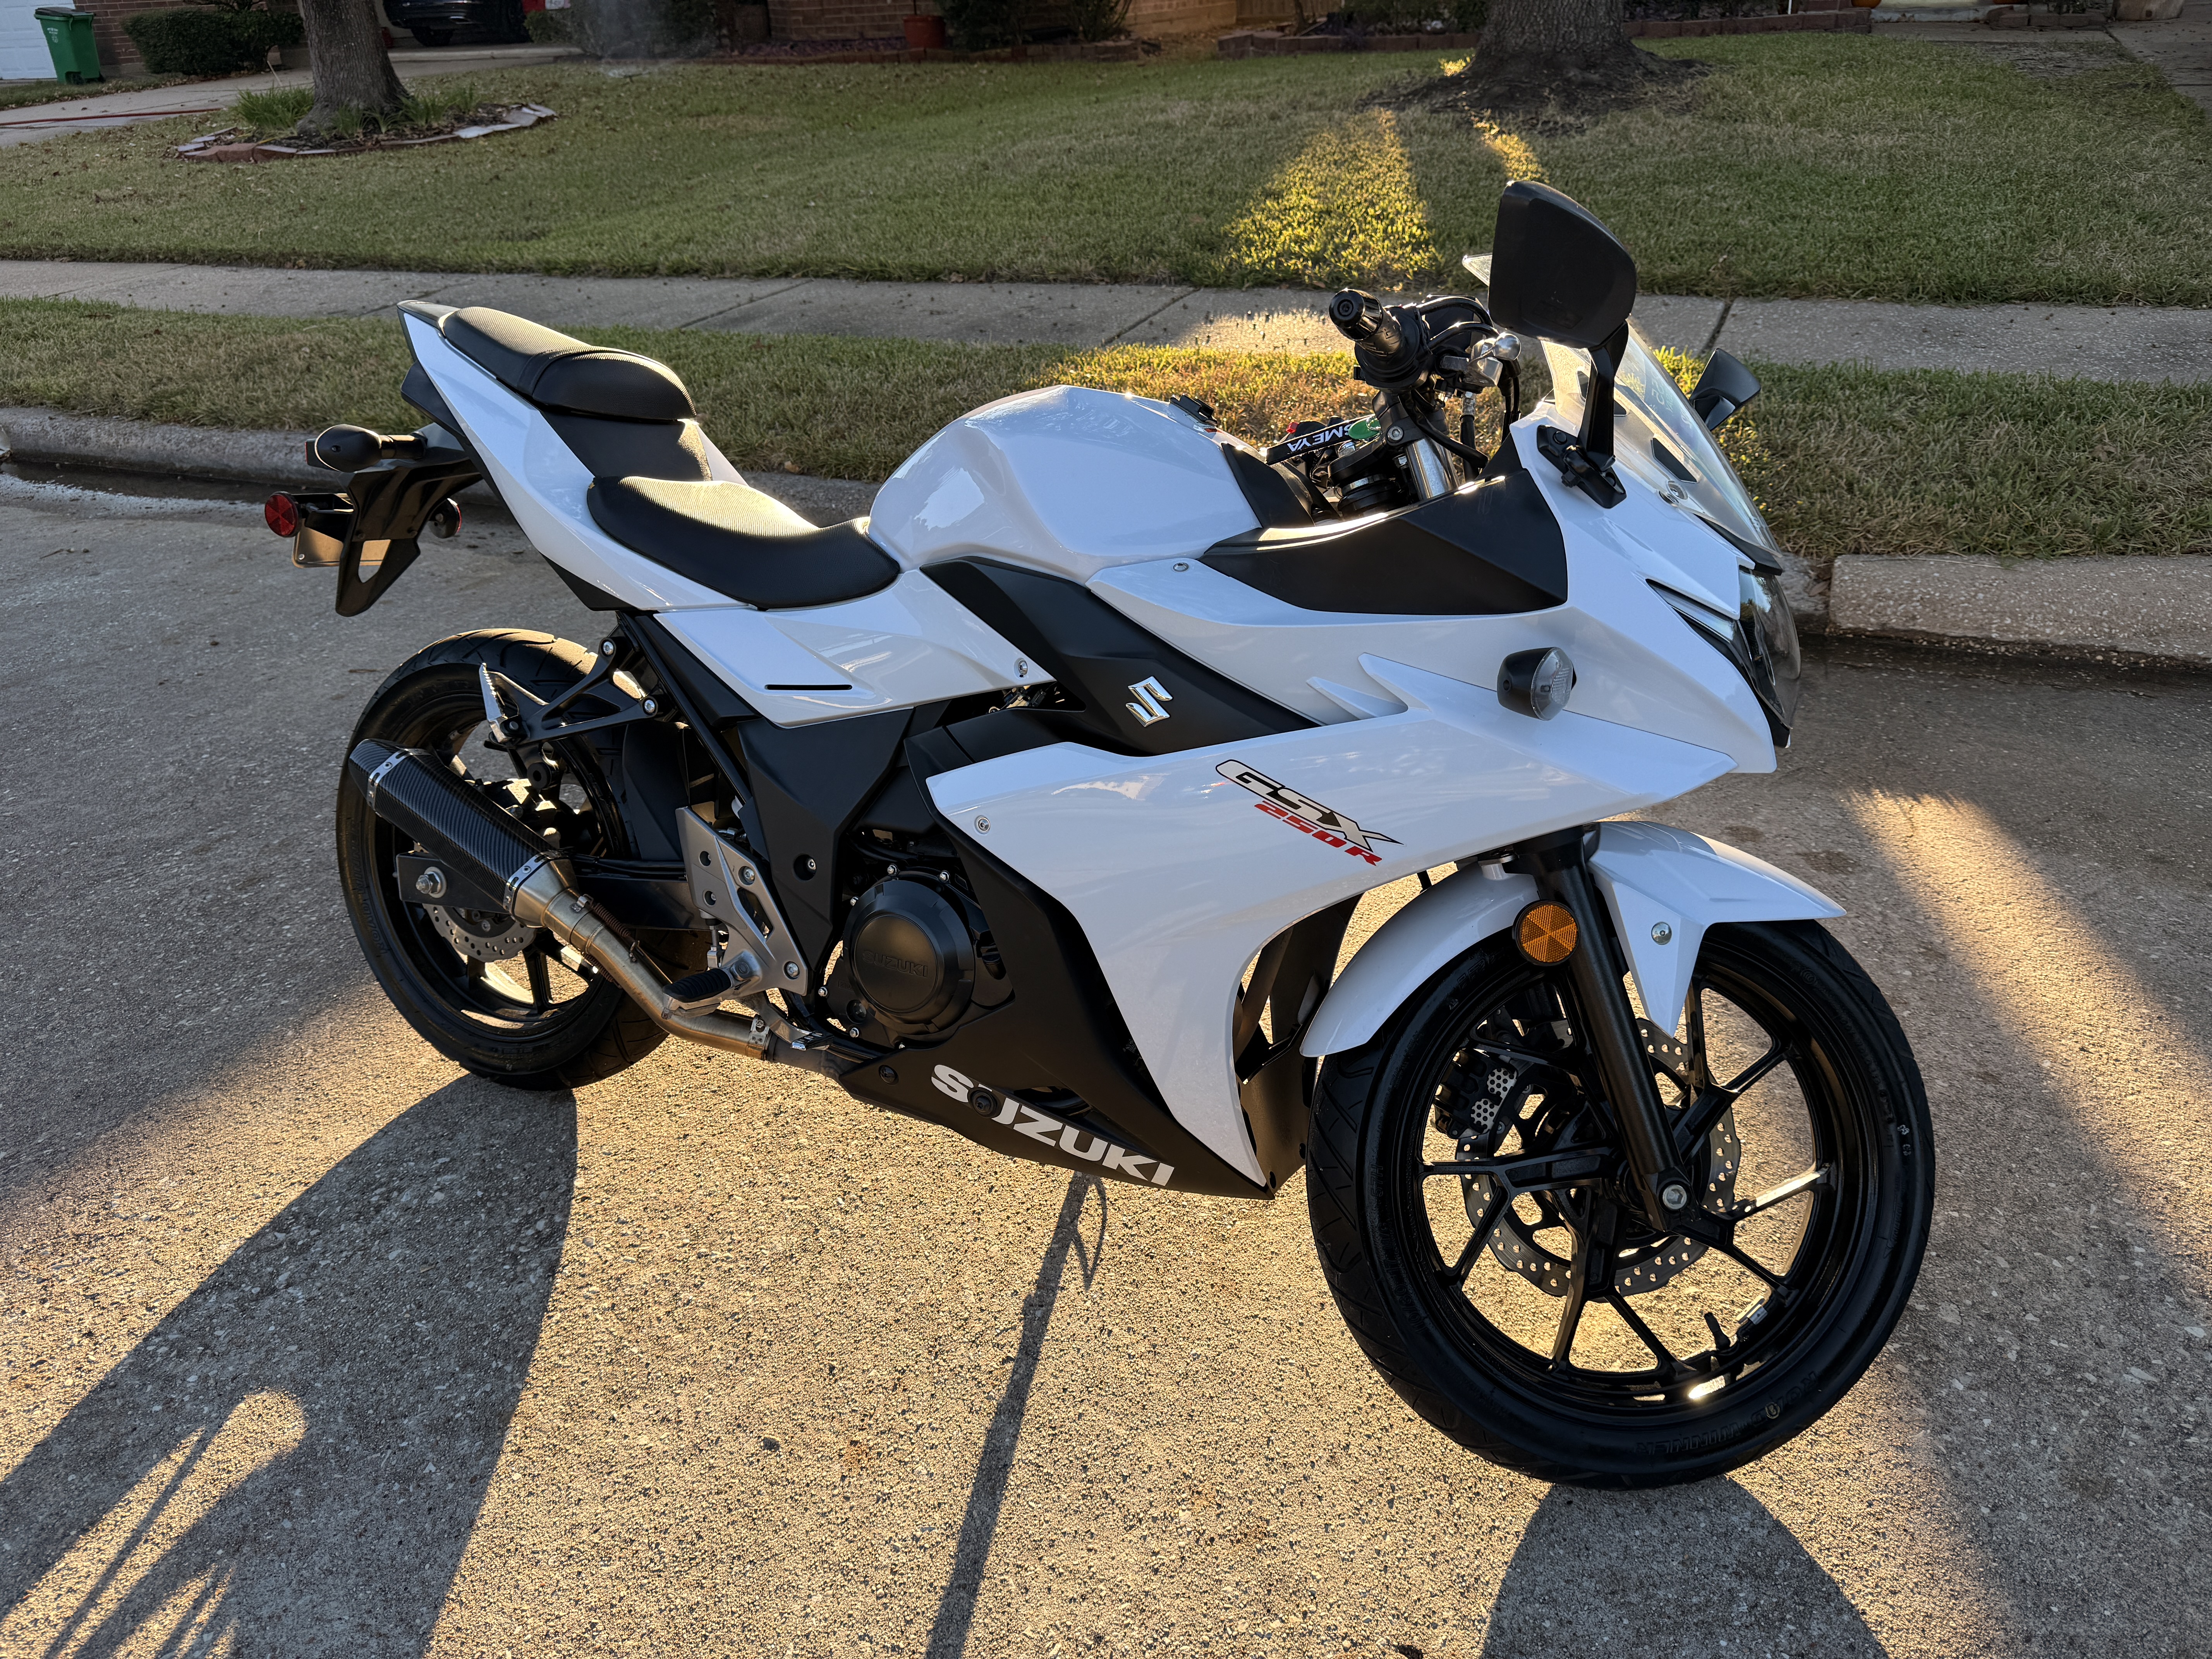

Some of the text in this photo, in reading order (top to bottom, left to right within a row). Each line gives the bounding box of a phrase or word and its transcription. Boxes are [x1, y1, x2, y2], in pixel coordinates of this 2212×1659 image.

[1215, 759, 1404, 852] GSX
[1254, 800, 1382, 866] 250R
[862, 951, 928, 978] SUZUKI
